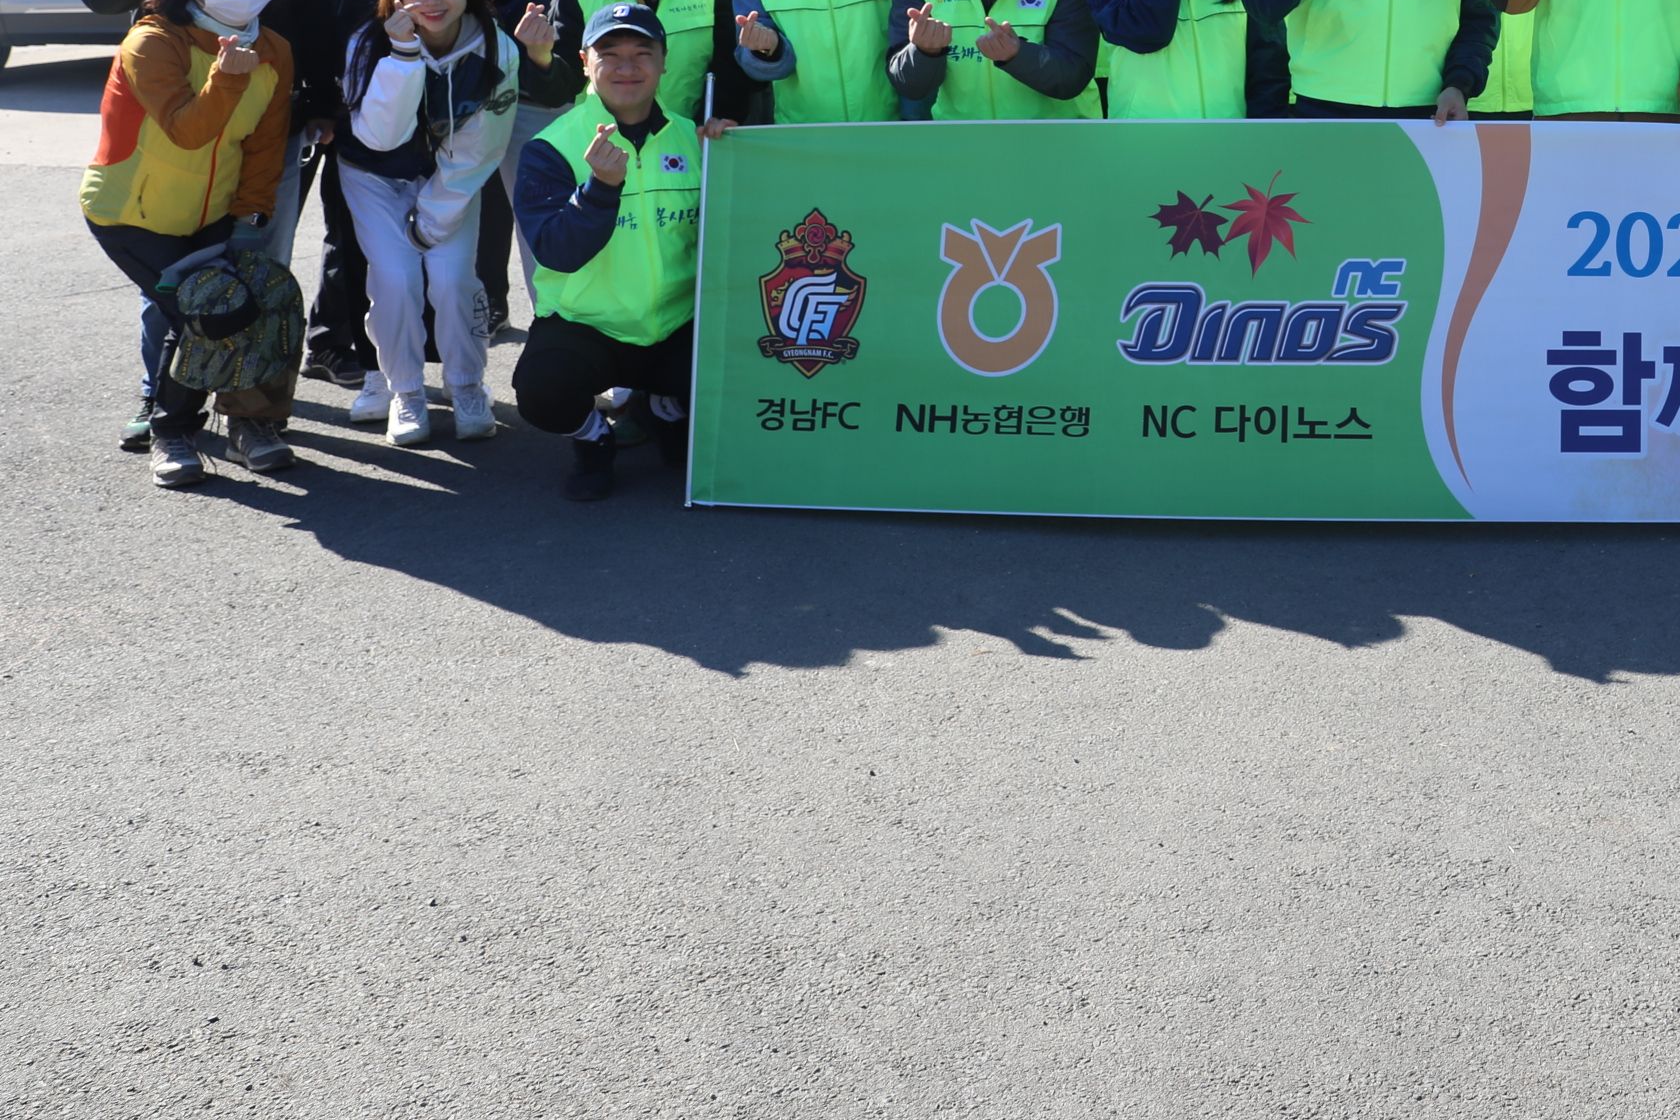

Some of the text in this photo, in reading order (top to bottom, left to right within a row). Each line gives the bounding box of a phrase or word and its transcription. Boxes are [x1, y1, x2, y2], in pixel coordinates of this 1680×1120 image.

[783, 349, 822, 358] GYEONGNAM
[755, 397, 861, 432] 경남FC
[895, 403, 1091, 438] NH농협은행
[1142, 404, 1373, 444] NC 다이노스
